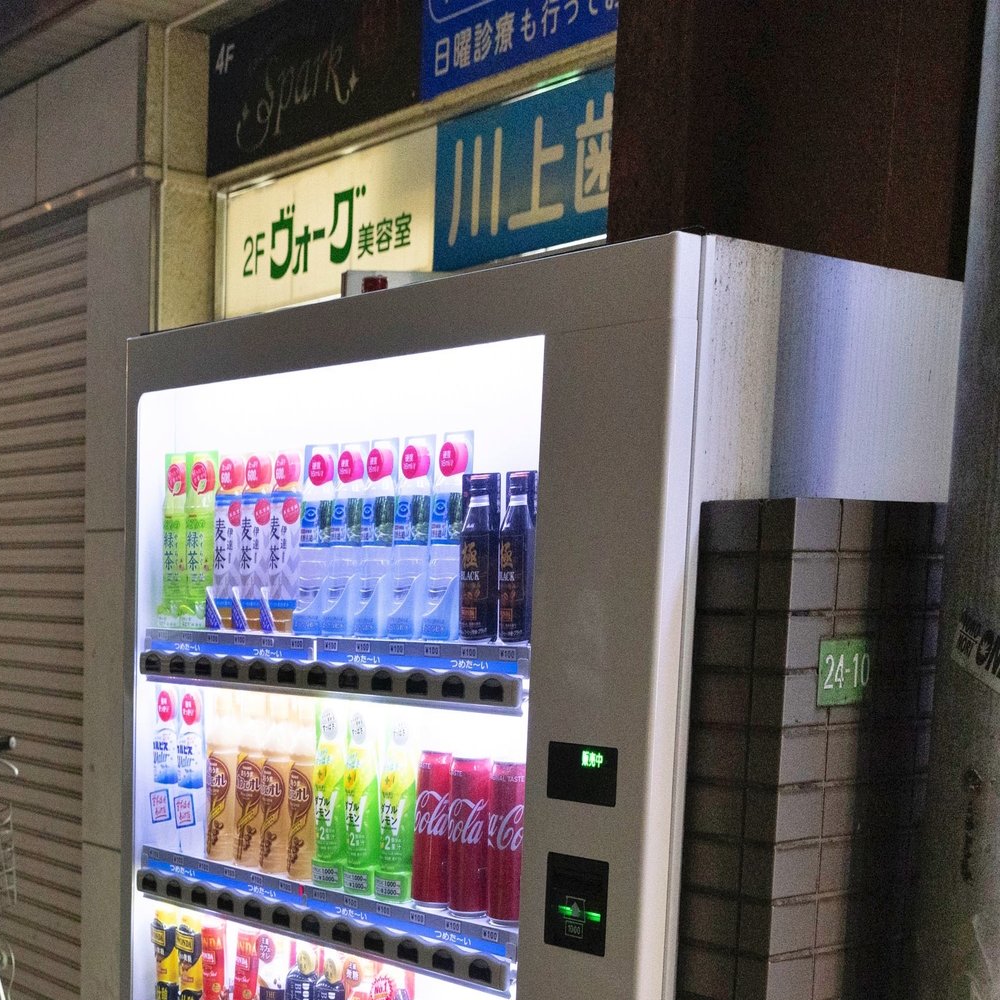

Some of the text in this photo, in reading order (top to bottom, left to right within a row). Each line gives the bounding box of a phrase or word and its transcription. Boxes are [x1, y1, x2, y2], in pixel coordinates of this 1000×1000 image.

[216, 43, 235, 75] 4F
[243, 184, 413, 280] 2F ヴォーグ 美容室
[163, 532, 174, 571] 緑茶
[187, 532, 199, 571] 緑茶
[215, 518, 226, 570] 麦茶
[241, 517, 252, 570] 麦茶
[270, 516, 280, 570] 麦茶
[325, 641, 337, 650] ¥100
[356, 642, 369, 651] ¥100
[390, 644, 404, 654] ¥100
[425, 646, 439, 655] ¥100
[462, 648, 476, 657] ¥100
[501, 649, 515, 660] ¥100
[823, 653, 870, 690] 24-10
[581, 751, 603, 768] 販売中
